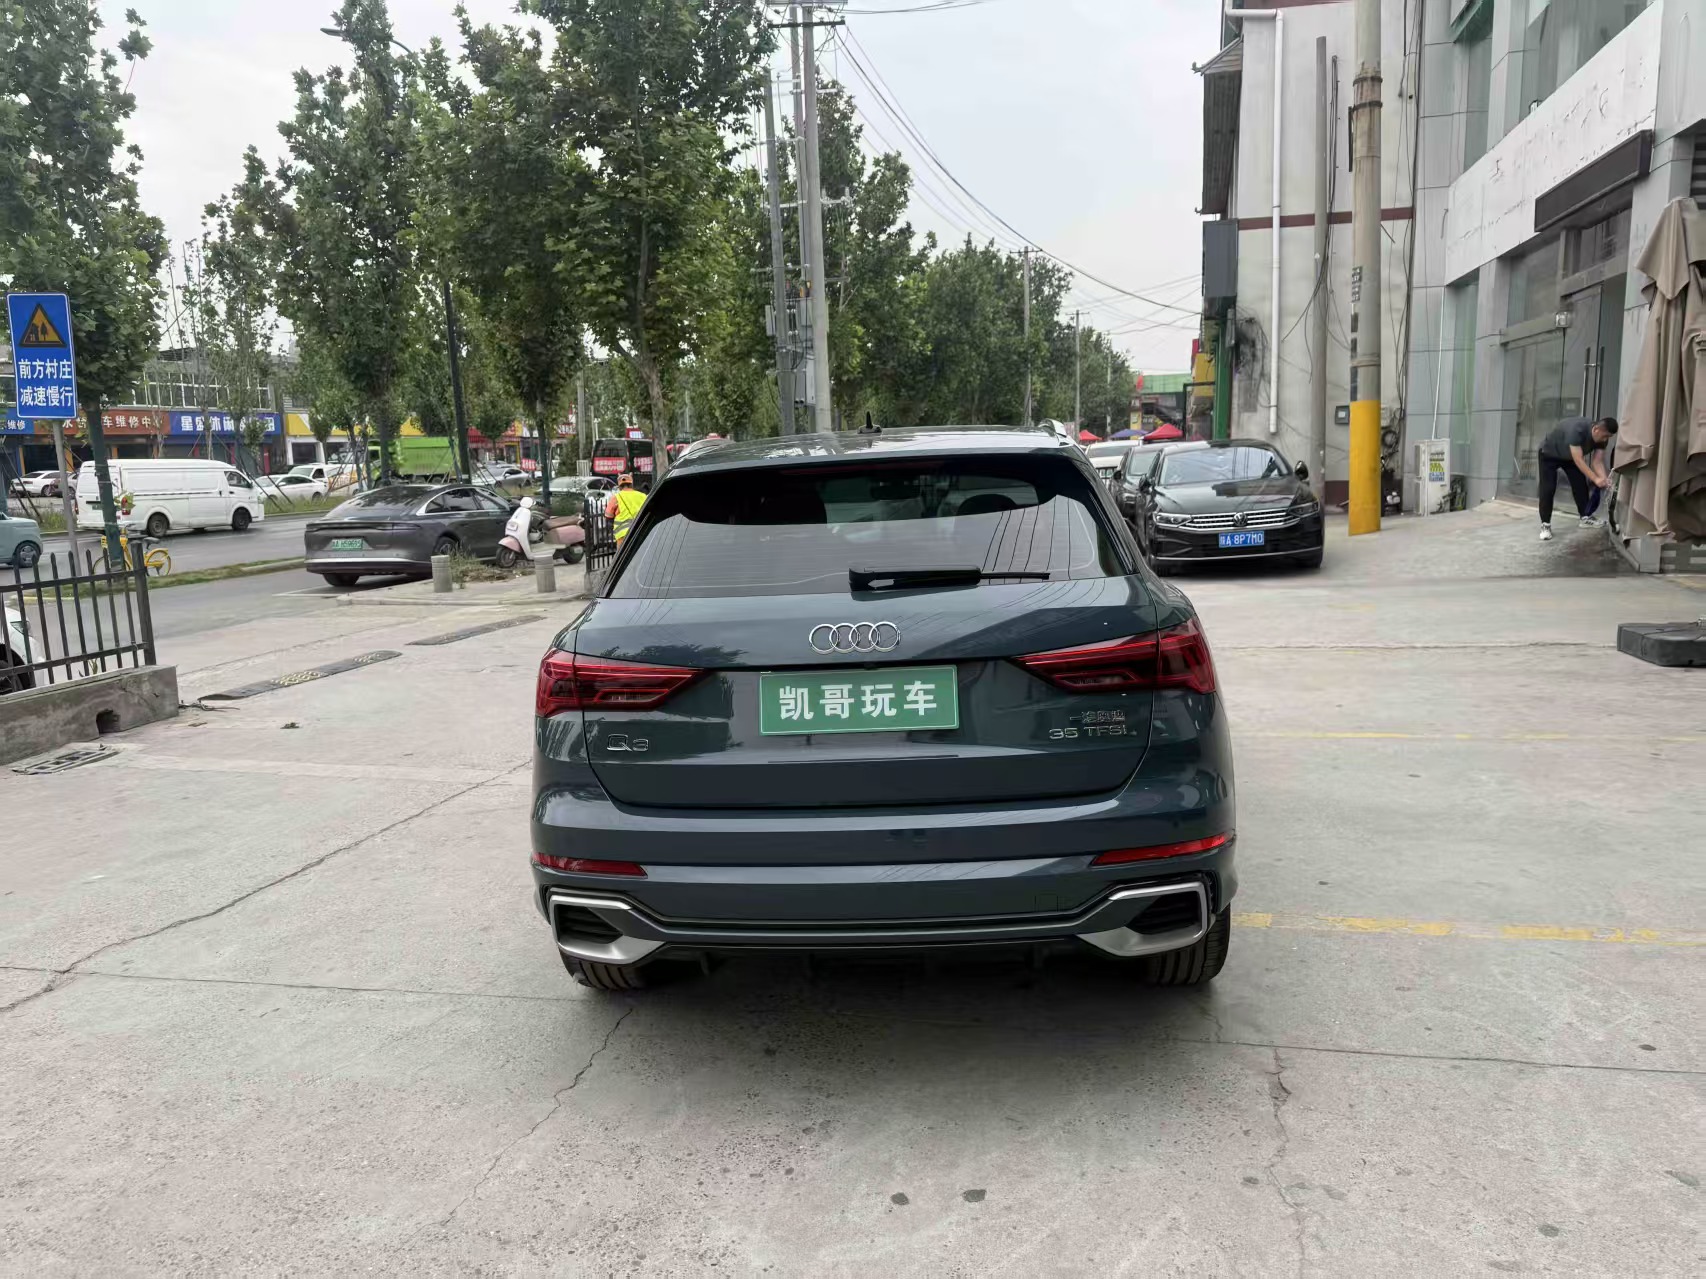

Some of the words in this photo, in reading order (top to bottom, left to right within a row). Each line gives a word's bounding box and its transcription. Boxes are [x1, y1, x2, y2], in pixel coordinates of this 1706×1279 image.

[18, 358, 72, 379] 前方村庄
[20, 386, 73, 407] 减速慢行
[0, 419, 26, 430] 维修
[778, 680, 938, 721] 凯哥玩车
[606, 733, 649, 752] Q3
[1048, 727, 1078, 740] 35
